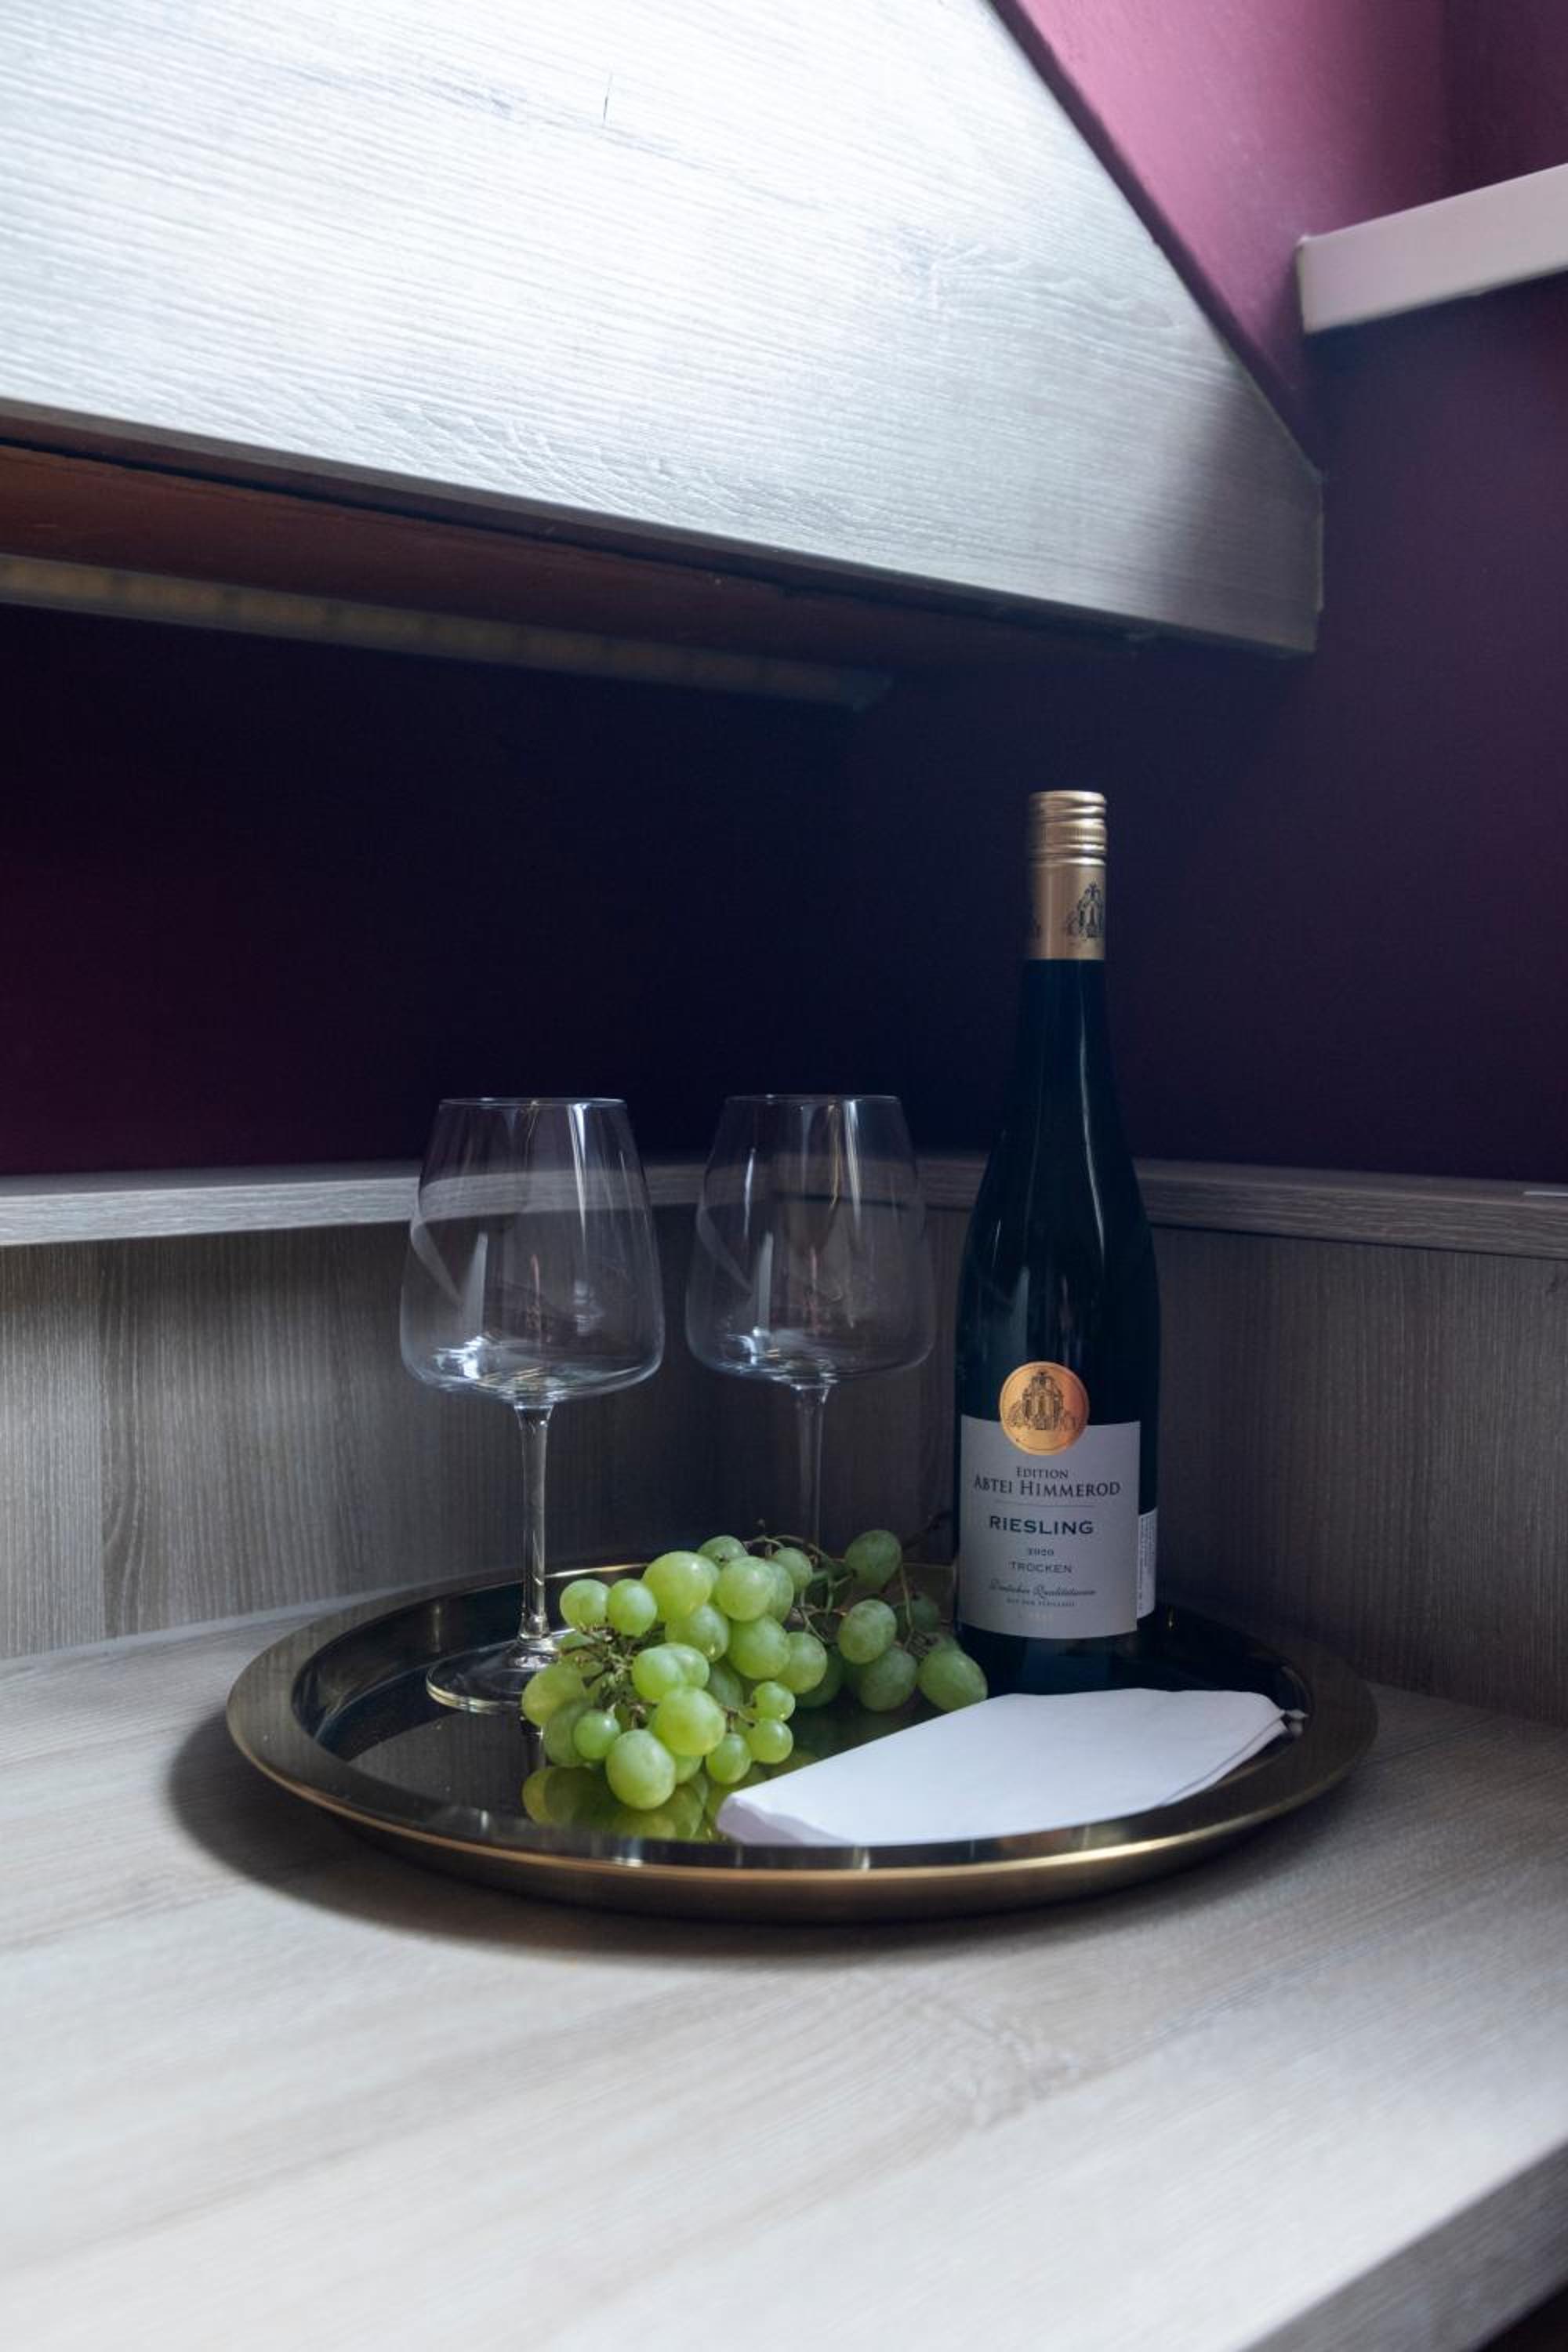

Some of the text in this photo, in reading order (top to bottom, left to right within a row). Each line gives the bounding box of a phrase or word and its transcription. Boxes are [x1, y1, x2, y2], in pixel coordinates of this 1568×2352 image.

[1017, 1467, 1069, 1479] EDITION
[1020, 1479, 1121, 1497] HIMMEROD
[990, 1515, 1094, 1534] RIESLING
[1008, 1561, 1073, 1574] TROCKEN
